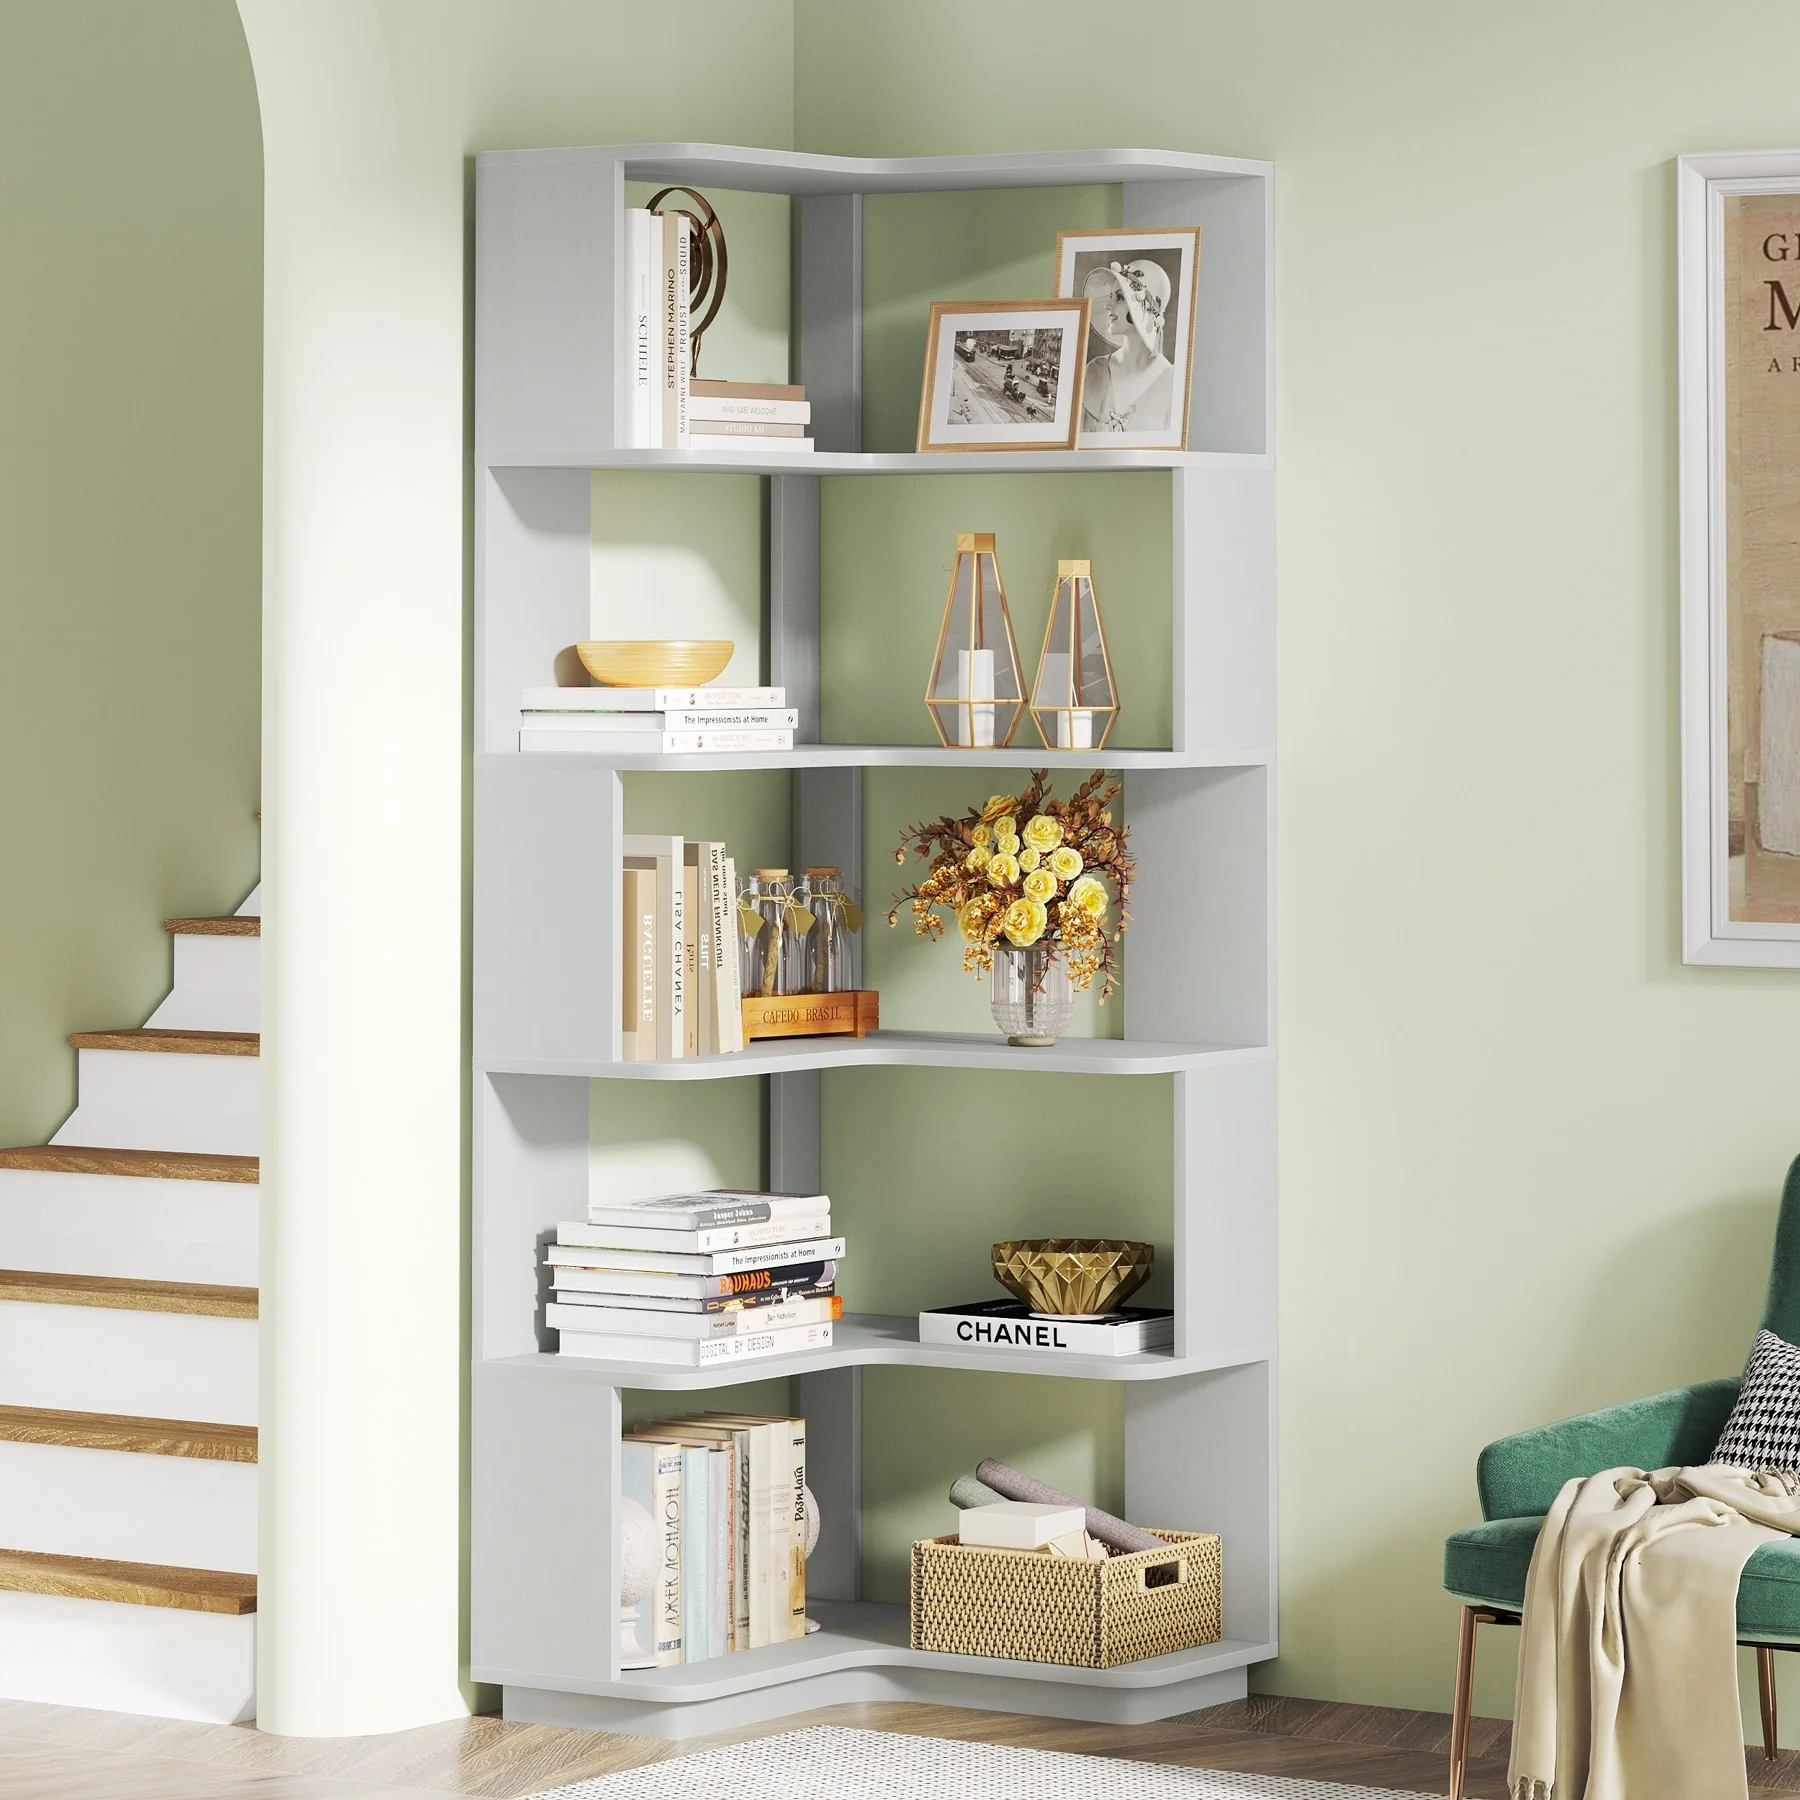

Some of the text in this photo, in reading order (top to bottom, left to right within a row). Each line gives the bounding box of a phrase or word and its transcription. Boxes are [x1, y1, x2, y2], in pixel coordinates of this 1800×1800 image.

[1763, 233, 1800, 262] G
[638, 314, 648, 387] SCHIELE
[724, 423, 753, 433] STUDIO
[685, 715, 768, 725] The Impressionists at Home
[763, 1007, 841, 1024] CAFEDO BRASIL
[732, 1257, 744, 1266] The
[744, 1251, 789, 1266] Impressionists
[798, 1248, 816, 1257] Home
[719, 1270, 771, 1294] BAUHAUS
[706, 1296, 756, 1311] DAA
[957, 1321, 1067, 1348] CHANEL
[700, 1335, 775, 1358] DIGITAL BY DESIGN
[665, 1487, 680, 1571] ЛОНДОН
[665, 1576, 680, 1627] ДЖЕК
